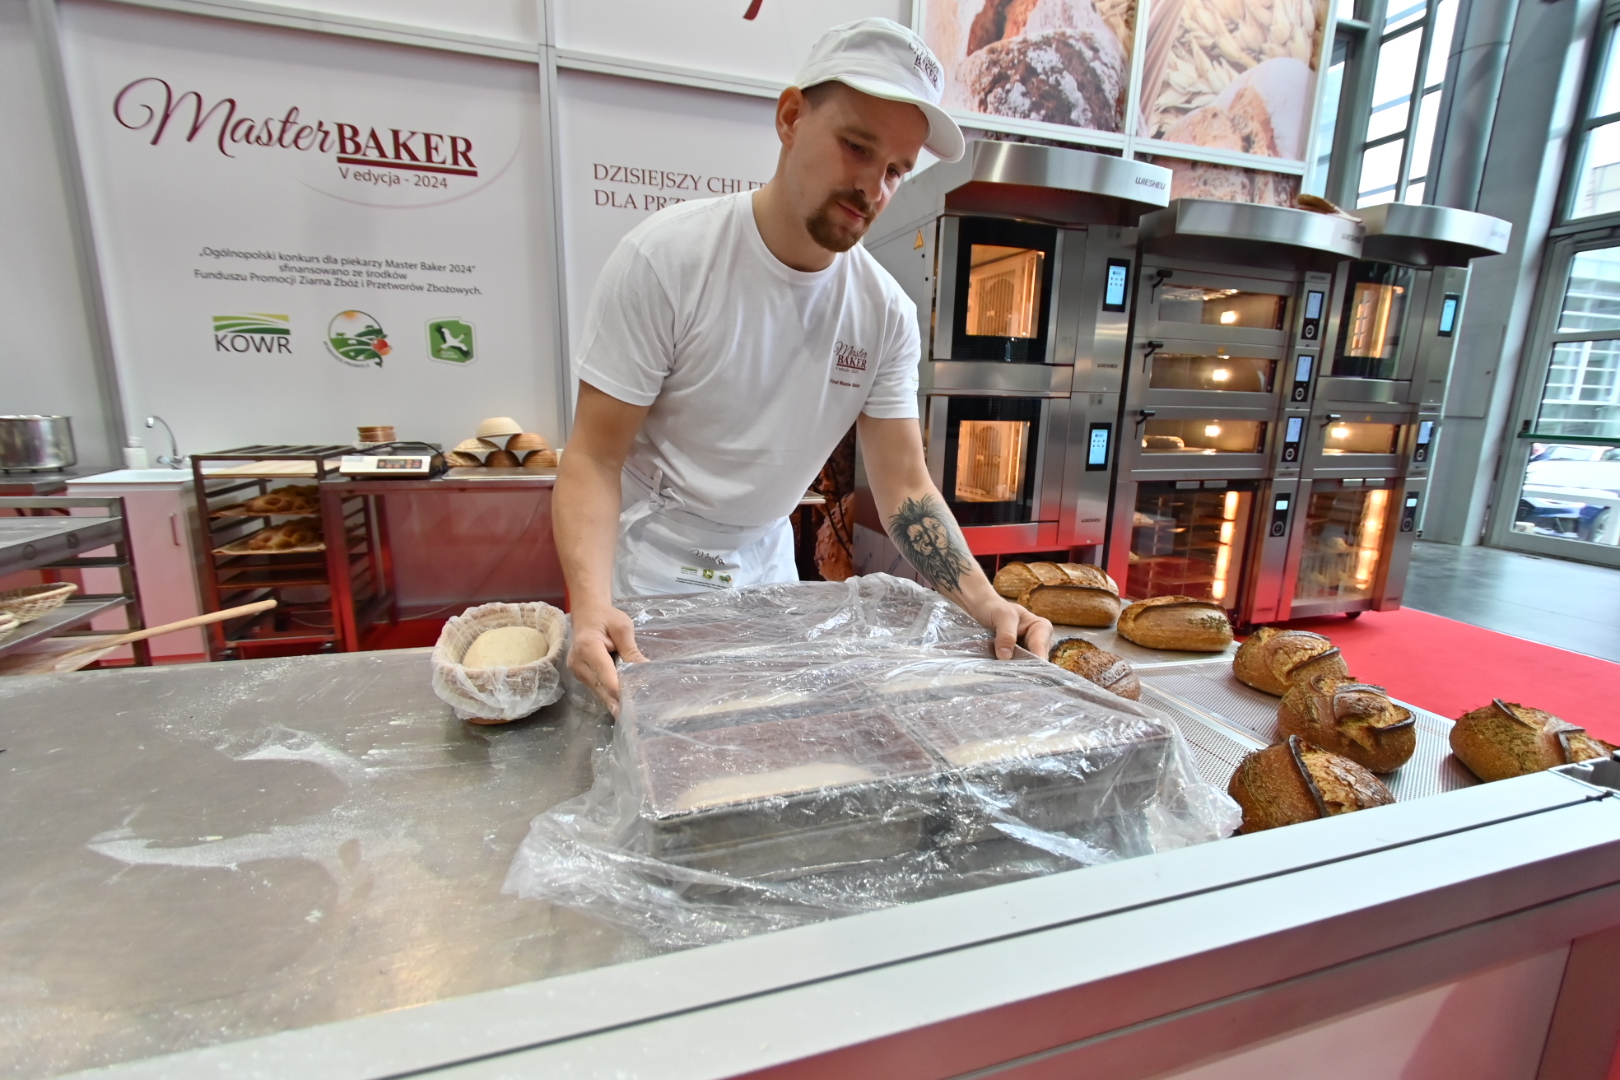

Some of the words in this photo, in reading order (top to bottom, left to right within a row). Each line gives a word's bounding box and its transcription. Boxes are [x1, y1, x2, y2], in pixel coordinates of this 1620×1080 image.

[113, 77, 335, 158] Master
[333, 122, 477, 168] BAKER
[338, 166, 349, 180] V
[353, 169, 401, 187] edycja
[413, 174, 448, 189] 2024
[593, 163, 701, 190] DZISIEJSZY
[1135, 176, 1166, 190] WIESHEU
[594, 189, 639, 210] DLA
[278, 252, 320, 264] konkurs
[322, 254, 338, 265] dla
[340, 257, 382, 268] piekarzy
[385, 259, 418, 270] Master
[420, 261, 447, 272] Baker
[278, 263, 350, 276] sfinansowano
[352, 269, 363, 277] ze
[365, 269, 408, 280] środków
[194, 269, 248, 281] Funduszu
[249, 272, 297, 286] Promocji
[298, 275, 332, 286] Ziarna
[334, 277, 359, 288] Zbóż
[366, 279, 424, 292] Przetworów
[214, 334, 292, 354] KOWR
[837, 355, 866, 368] BAKER
